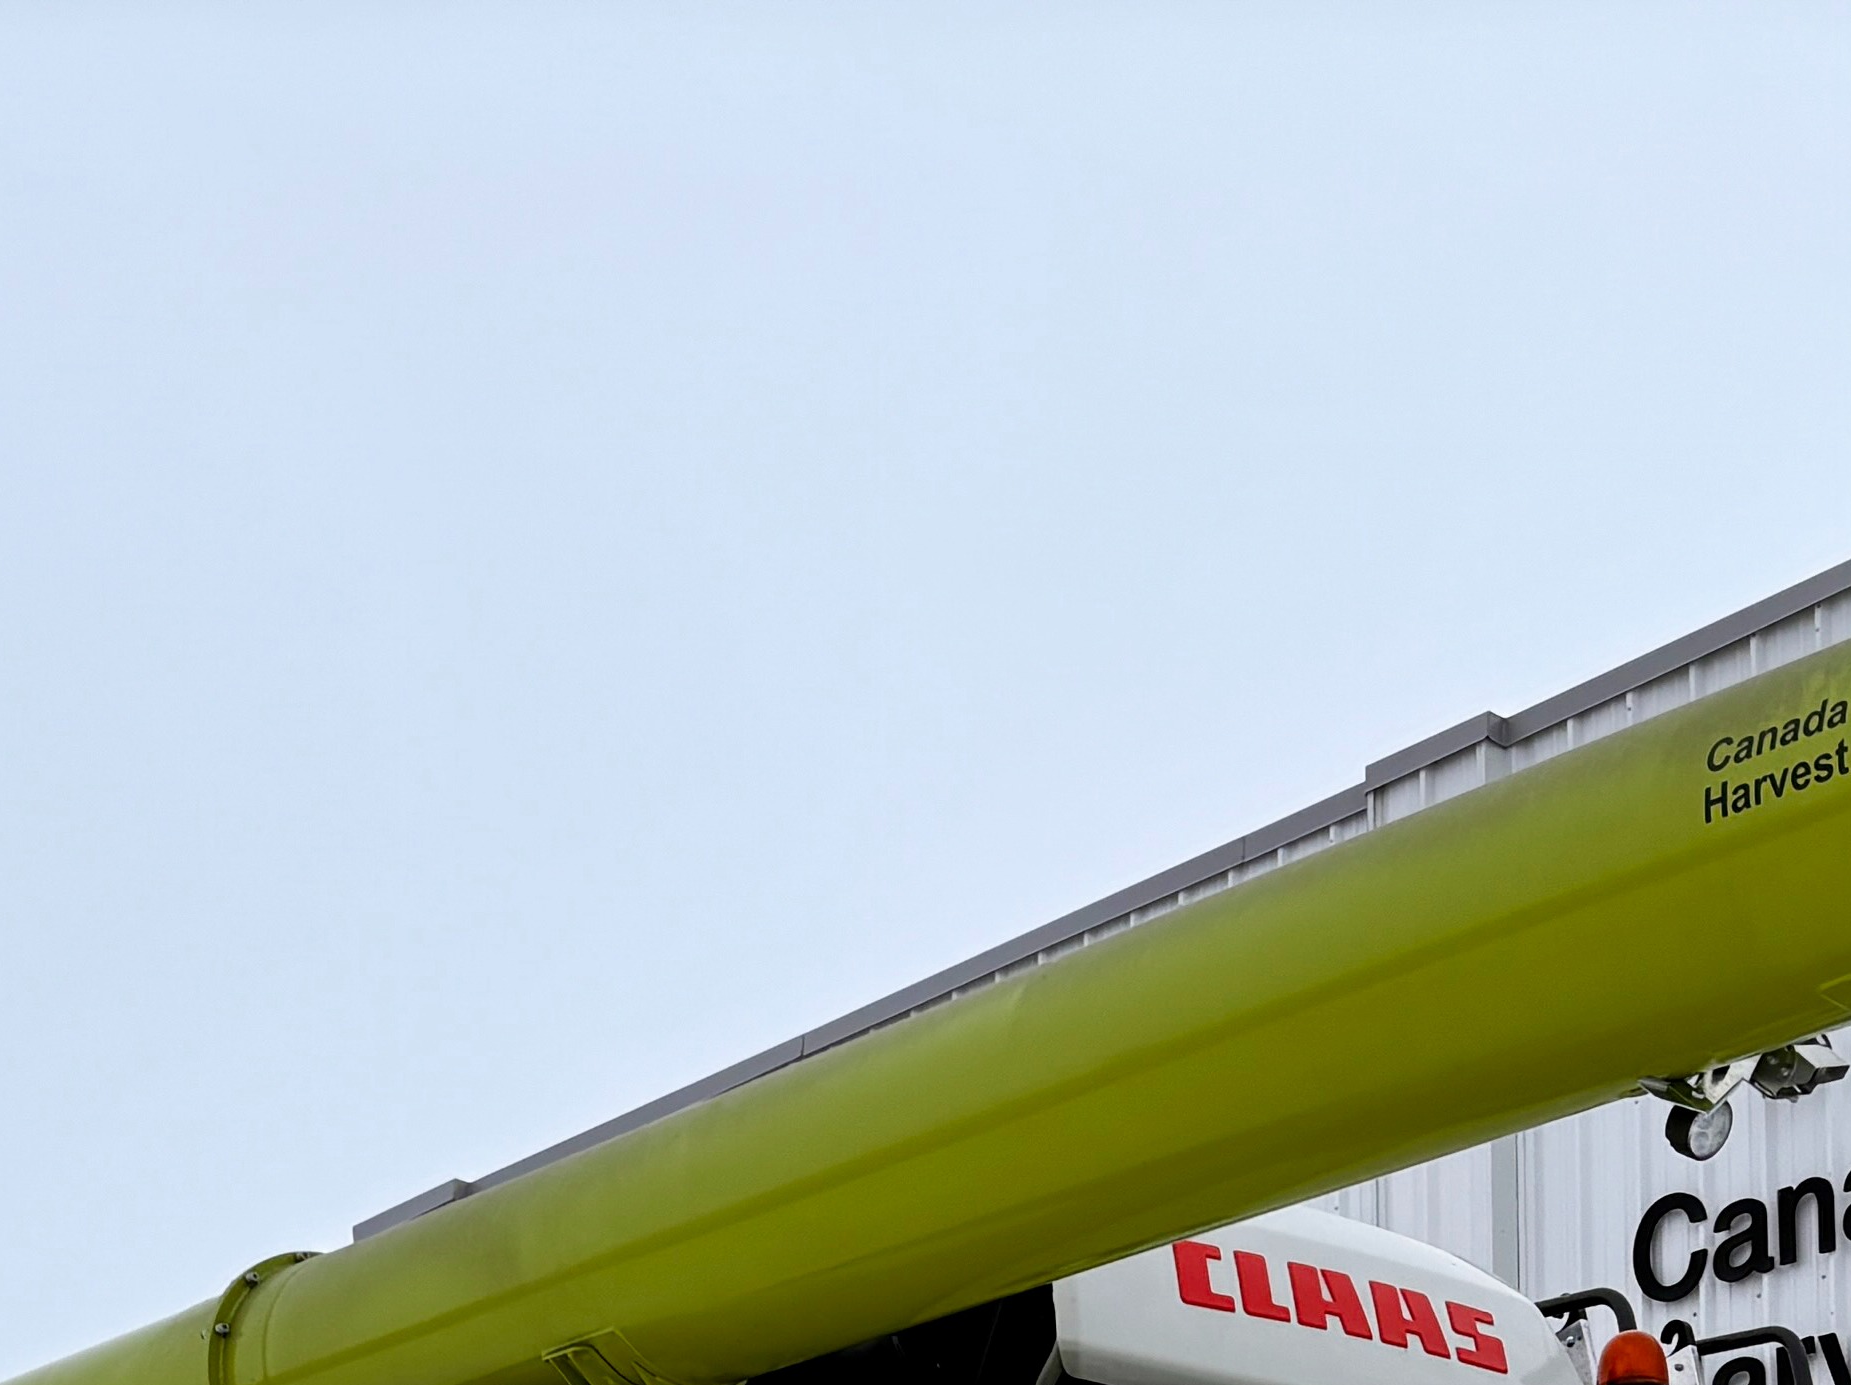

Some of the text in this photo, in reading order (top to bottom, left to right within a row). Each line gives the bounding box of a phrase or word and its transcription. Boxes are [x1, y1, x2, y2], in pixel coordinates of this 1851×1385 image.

[1707, 698, 1848, 772] Canada
[1704, 739, 1850, 824] Harvest
[1172, 1239, 1509, 1375] CLAAS
